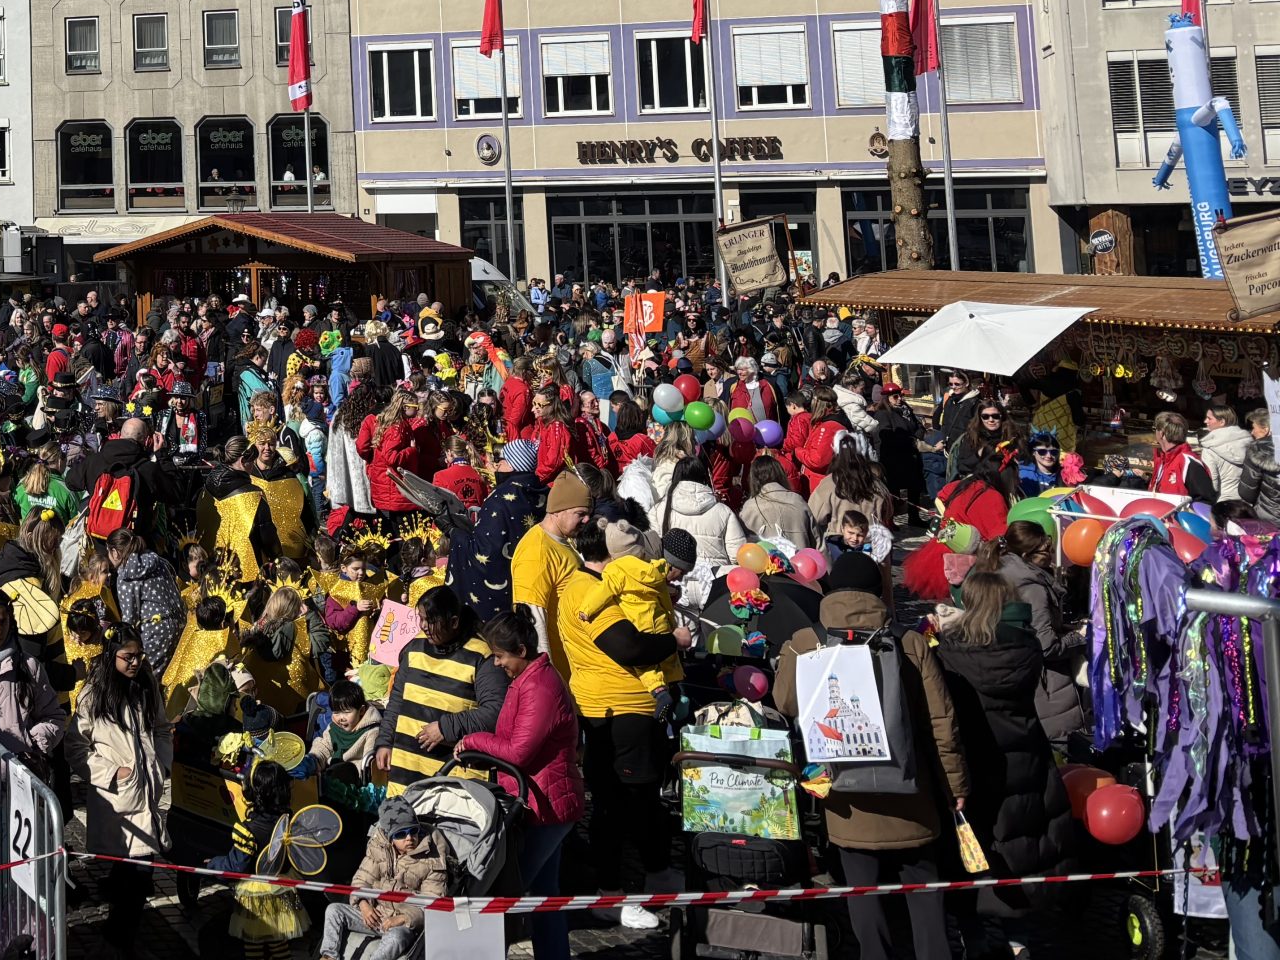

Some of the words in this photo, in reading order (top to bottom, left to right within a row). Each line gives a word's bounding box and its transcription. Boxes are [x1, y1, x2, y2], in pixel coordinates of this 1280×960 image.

[71, 131, 103, 145] eber
[139, 129, 172, 144] eber
[210, 128, 244, 142] eber
[576, 136, 679, 163] HENRY'S
[691, 136, 784, 162] COFFEE
[58, 219, 155, 235] eber
[723, 229, 765, 249] ERLINGER
[709, 771, 724, 785] Pro
[727, 773, 763, 788] Climate
[12, 808, 33, 864] 22
